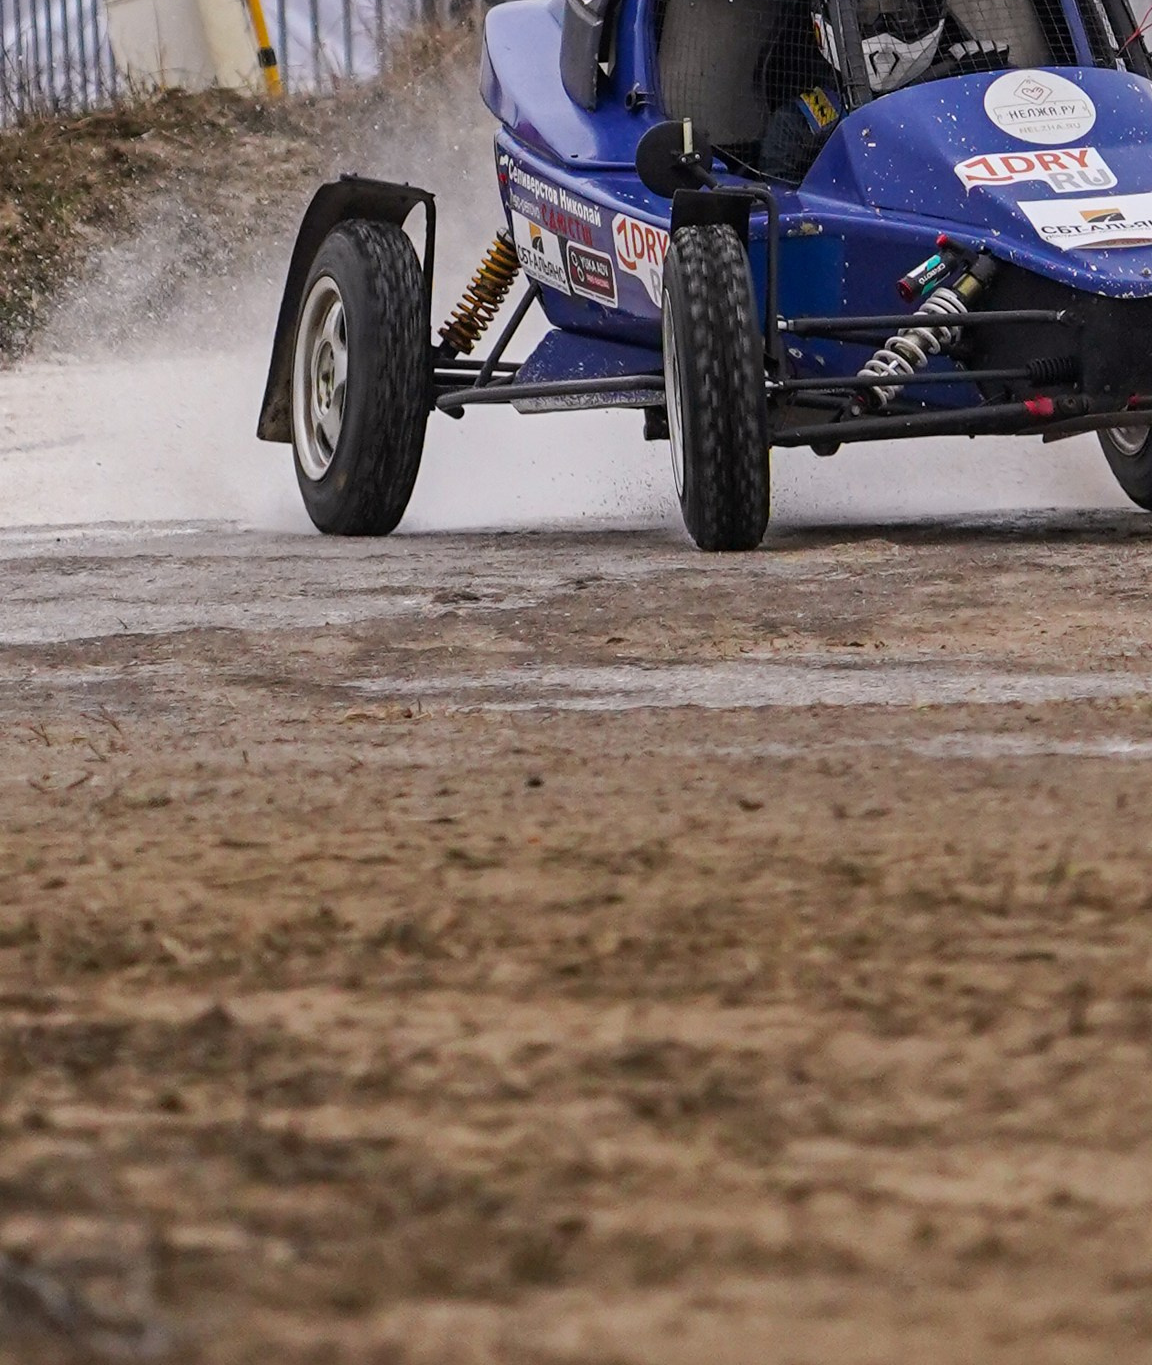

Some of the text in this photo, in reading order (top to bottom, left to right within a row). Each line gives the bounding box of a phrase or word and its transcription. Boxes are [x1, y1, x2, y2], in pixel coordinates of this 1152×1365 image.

[964, 150, 1089, 178] 1DRY
[508, 158, 558, 206] Селиверстов
[559, 187, 602, 228] Николай
[1050, 168, 1112, 190] RU
